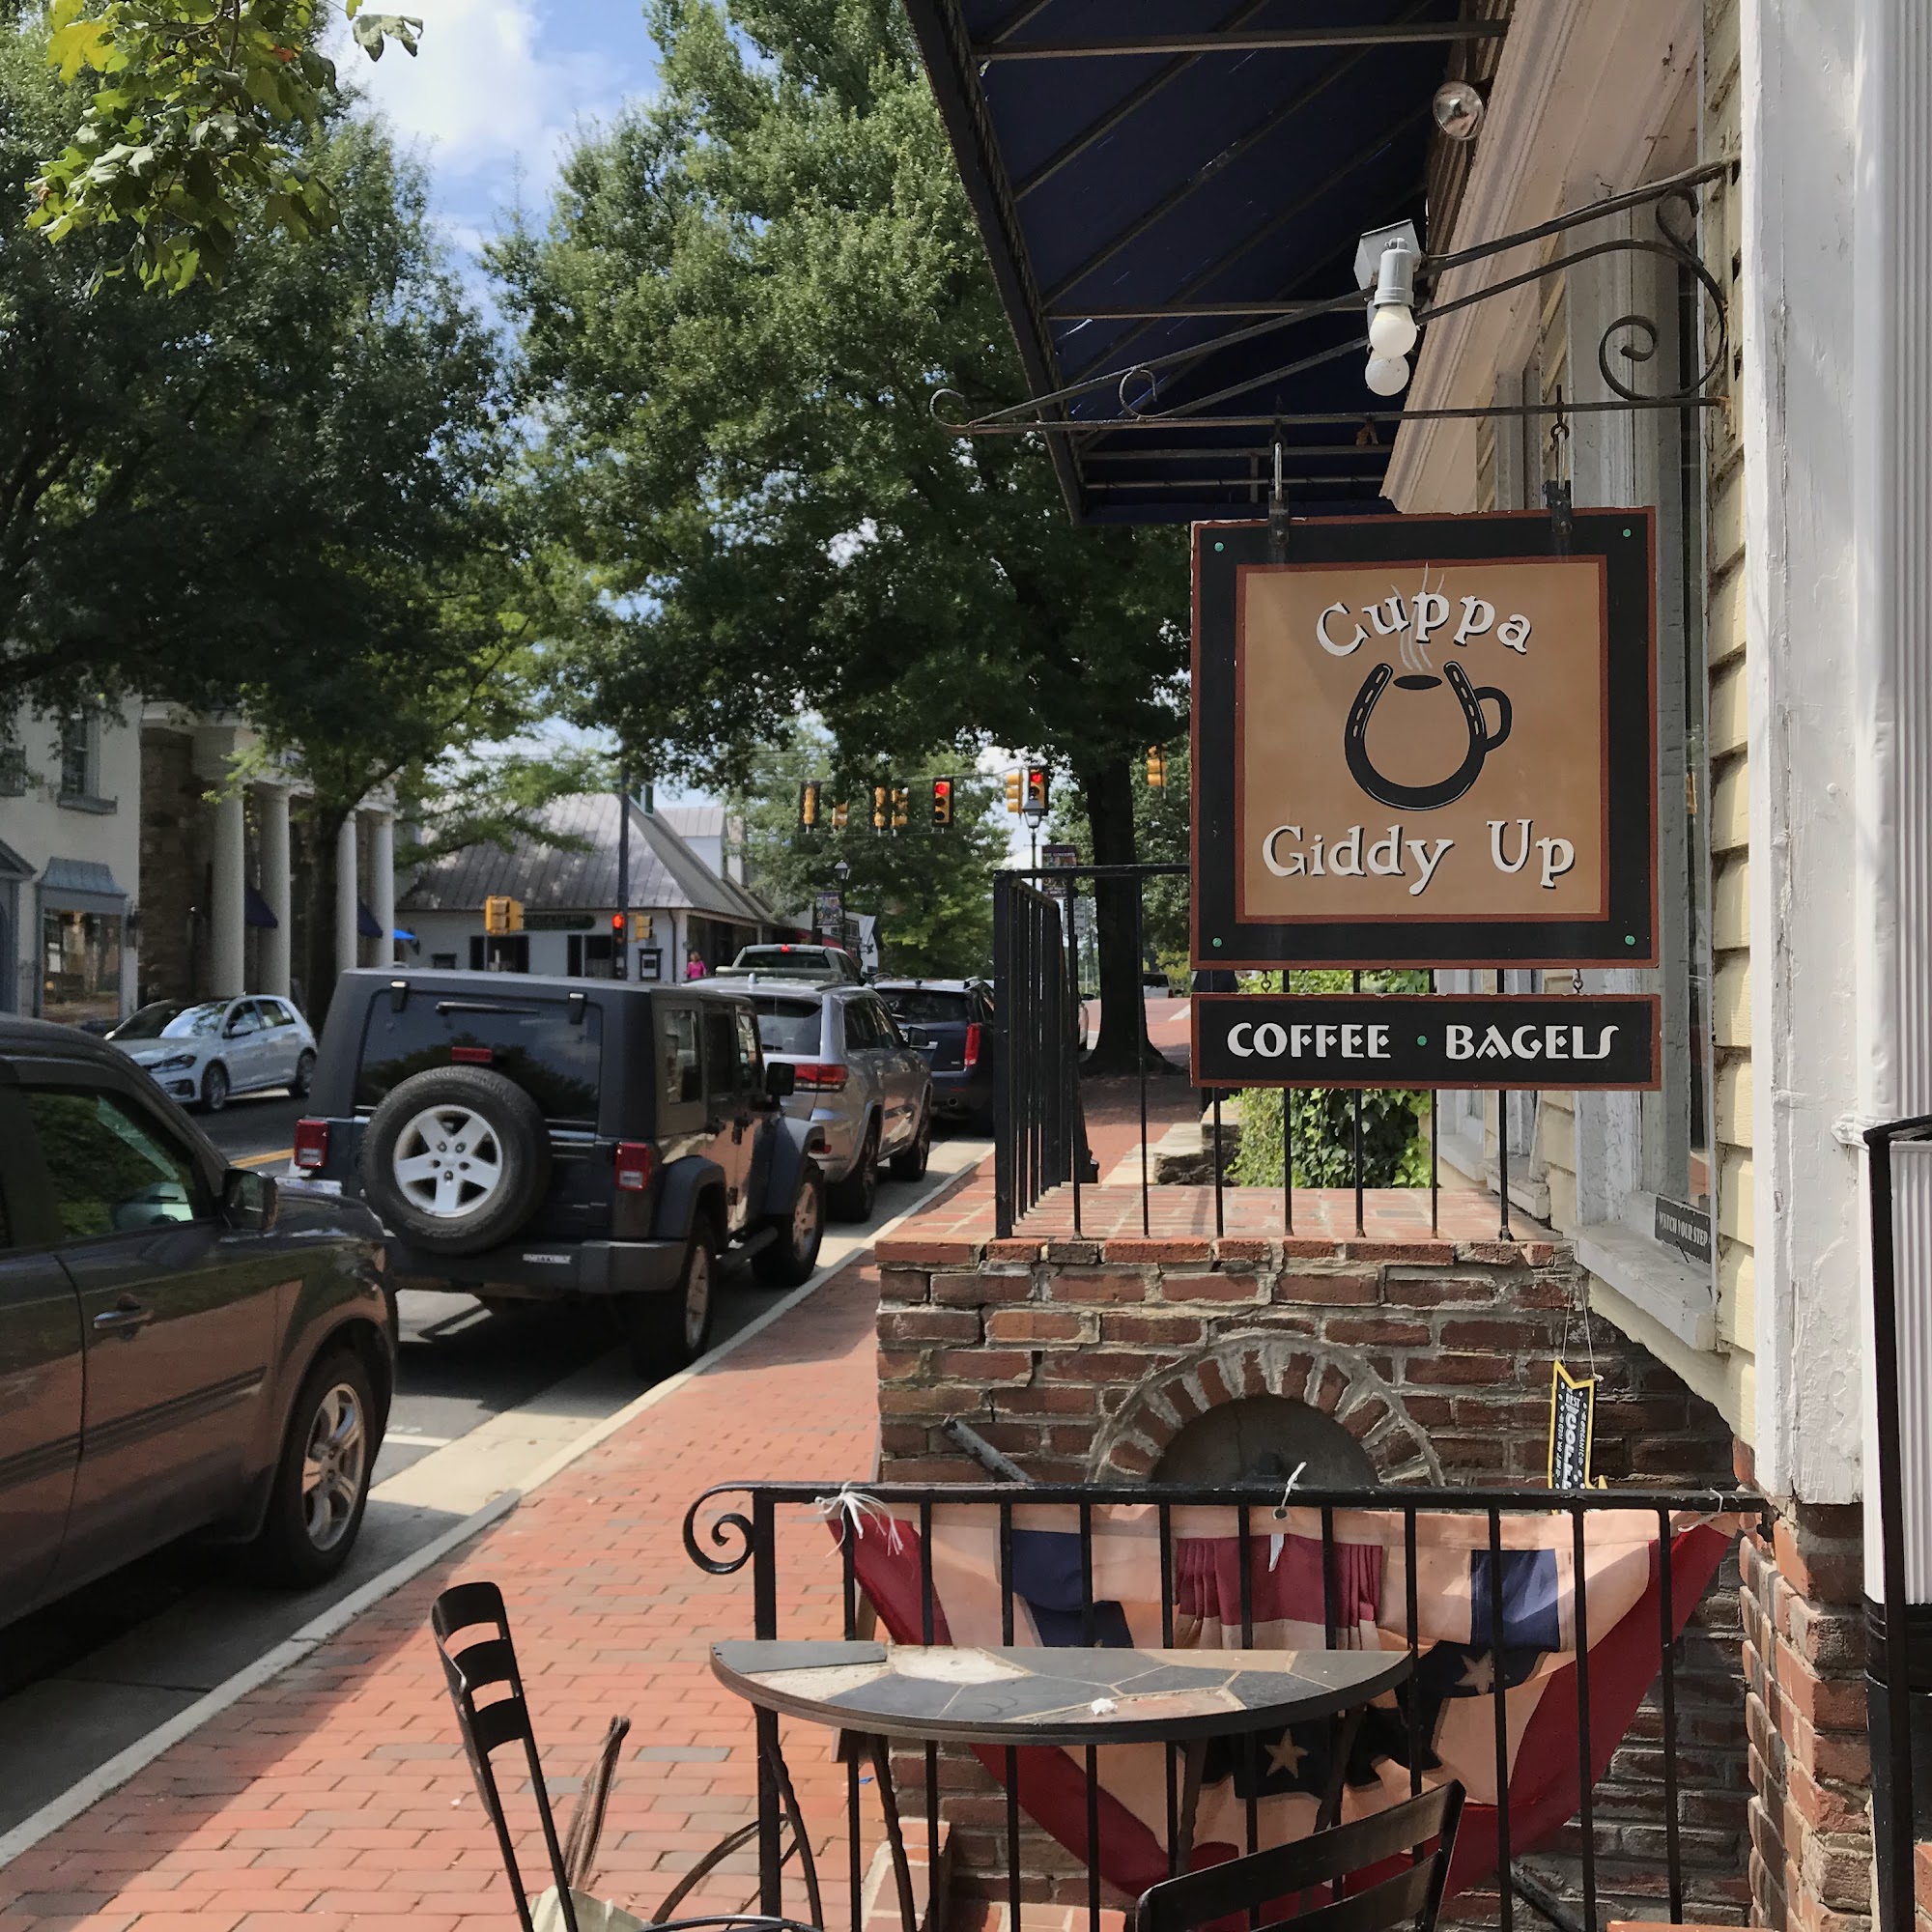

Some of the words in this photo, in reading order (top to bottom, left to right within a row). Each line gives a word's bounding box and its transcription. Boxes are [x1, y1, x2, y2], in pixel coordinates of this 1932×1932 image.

[1316, 591, 1533, 657] Cuppa
[1262, 824, 1455, 896] Giddy
[1487, 819, 1577, 890] Up
[1227, 1022, 1392, 1059] COFFEE
[1445, 1024, 1620, 1061] BAGELS
[1659, 1210, 1677, 1234] WATCH
[1678, 1219, 1692, 1241] YOUR
[1693, 1226, 1708, 1247] STEP
[1566, 1393, 1580, 1407] BEST
